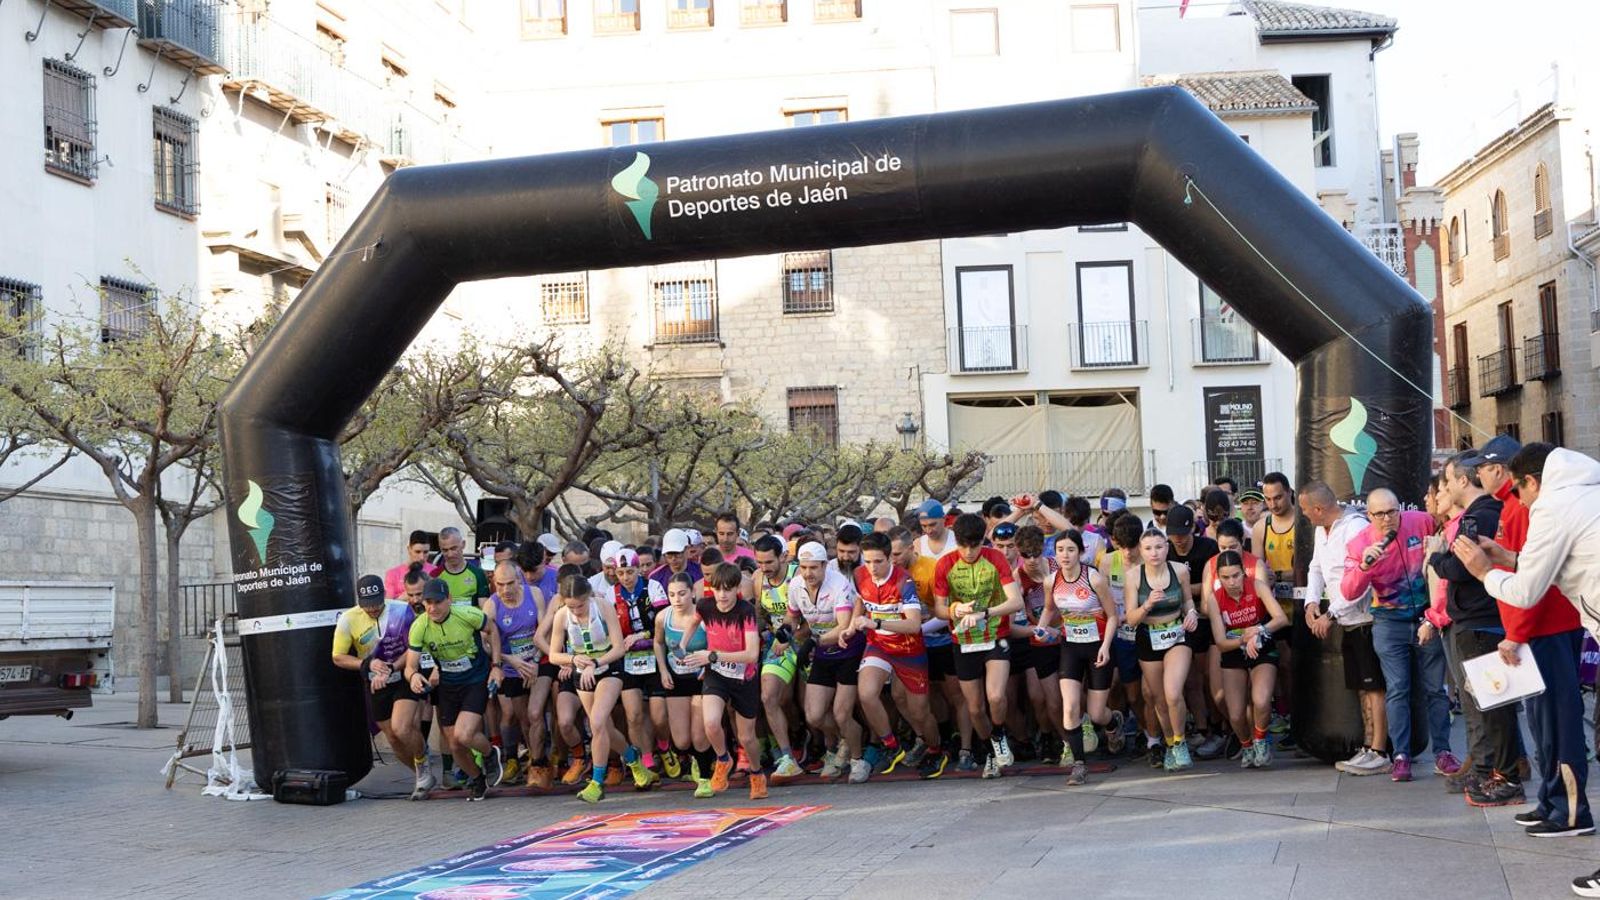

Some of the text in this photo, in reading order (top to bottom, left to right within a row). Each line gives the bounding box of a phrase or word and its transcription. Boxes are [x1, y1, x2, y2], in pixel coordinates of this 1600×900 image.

[666, 156, 902, 194] Patronato Municipal de
[668, 182, 848, 219] Deportes de Jaén
[1229, 403, 1253, 411] MOLINO
[259, 563, 308, 577] Municipal
[310, 562, 323, 572] de
[237, 574, 311, 593] Deportes de Jaén
[1160, 631, 1177, 640] 649
[720, 661, 737, 671] 619
